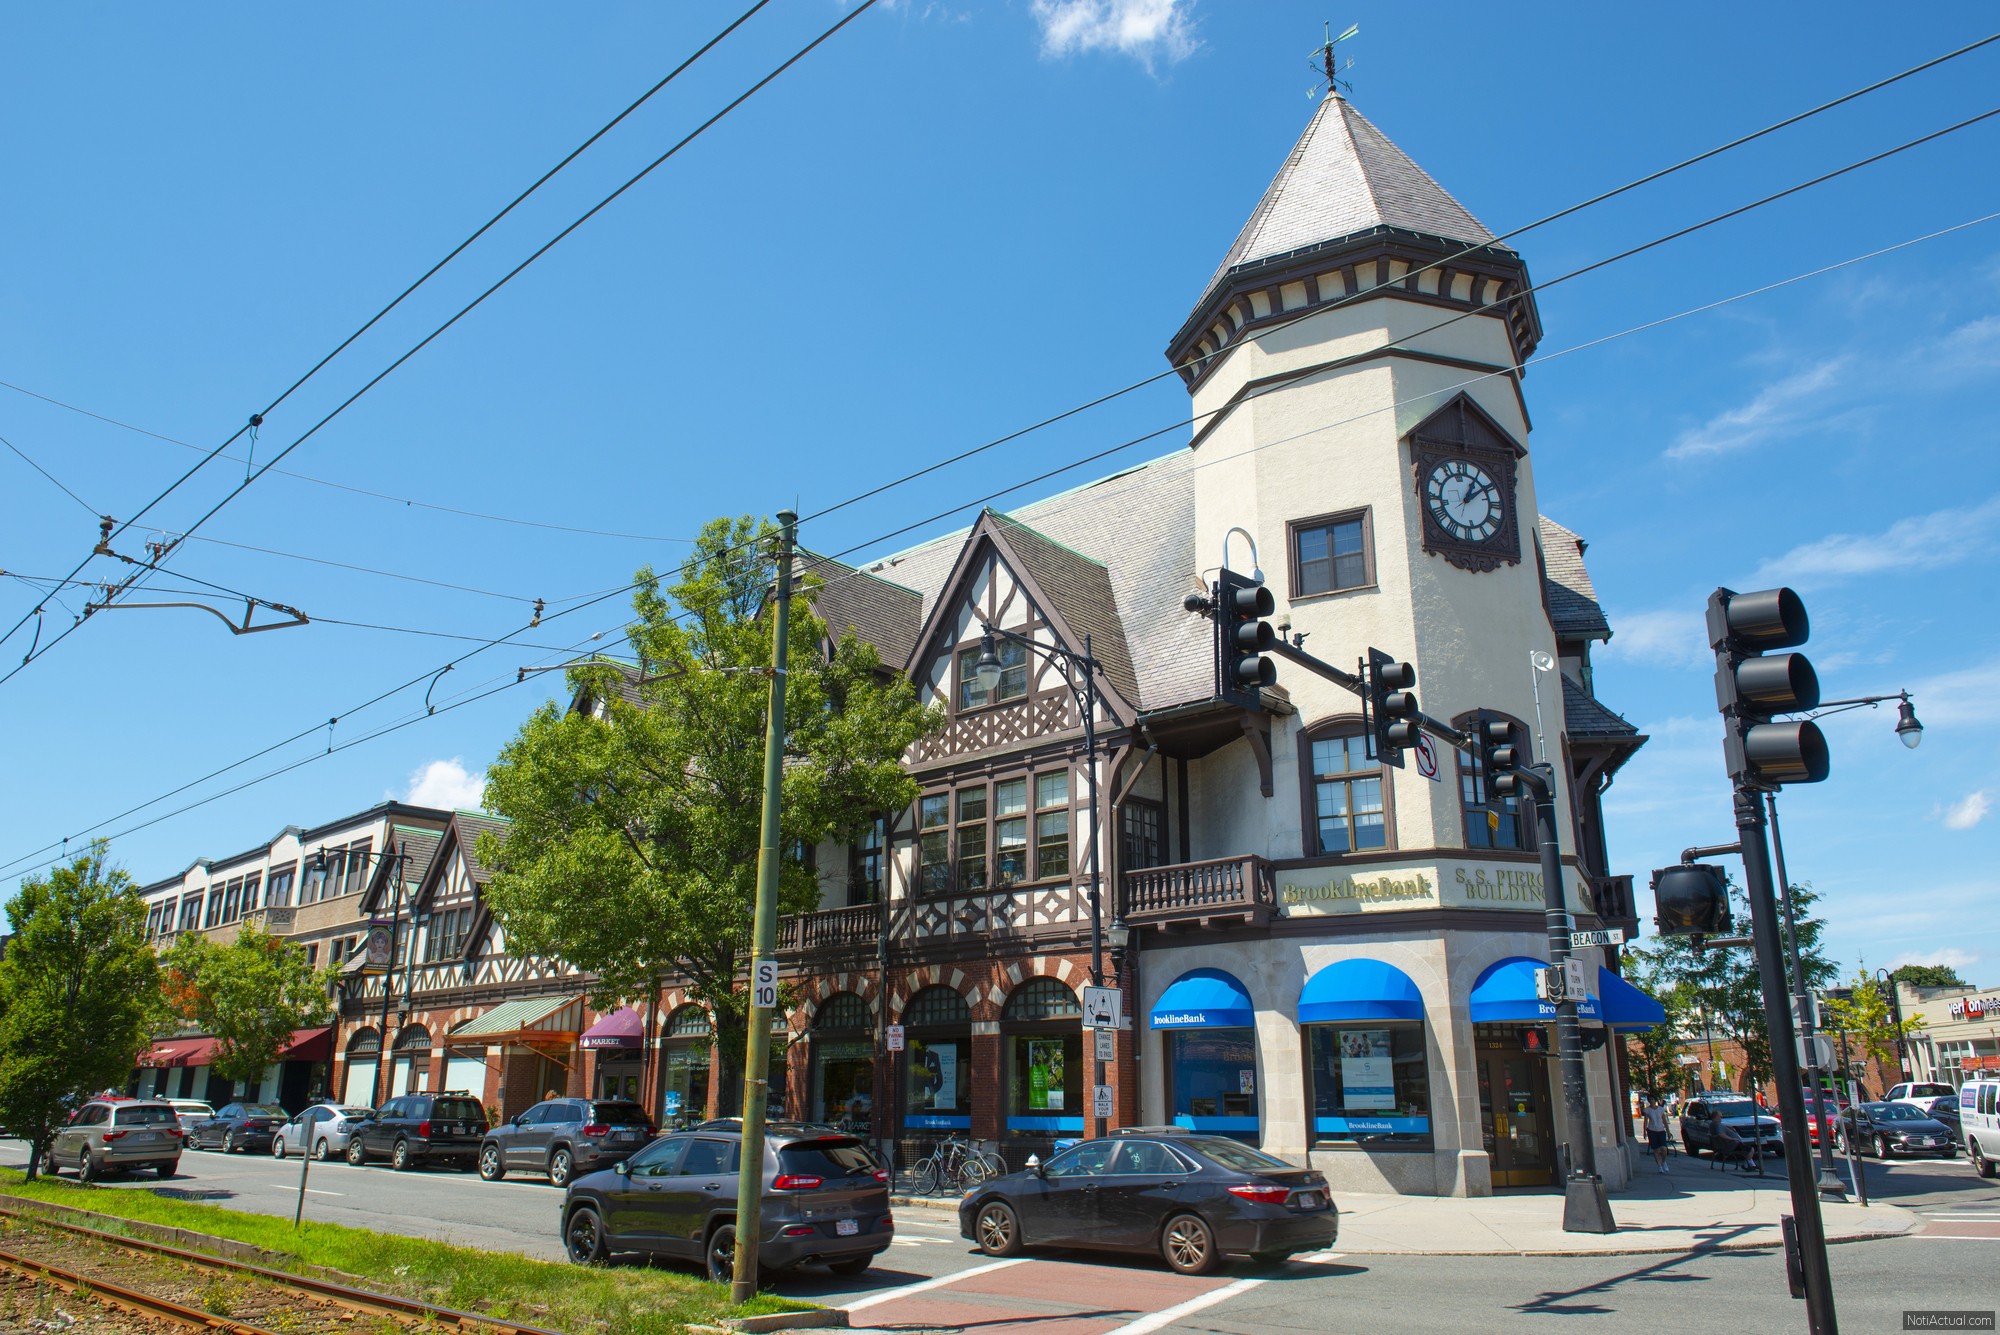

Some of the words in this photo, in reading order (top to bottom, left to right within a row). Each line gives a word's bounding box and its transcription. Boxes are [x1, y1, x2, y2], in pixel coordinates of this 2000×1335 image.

[1456, 867, 1471, 884] S.
[1476, 868, 1491, 885] S.
[1496, 869, 1544, 888] PIERC
[1284, 873, 1429, 902] BrooklineBank
[1573, 931, 1610, 946] BEACON
[759, 965, 773, 983] S
[756, 986, 774, 1005] 10
[1539, 1003, 1596, 1015] BroeBank
[591, 1038, 620, 1046] MARKET
[1348, 1121, 1393, 1130] BrooklineBank
